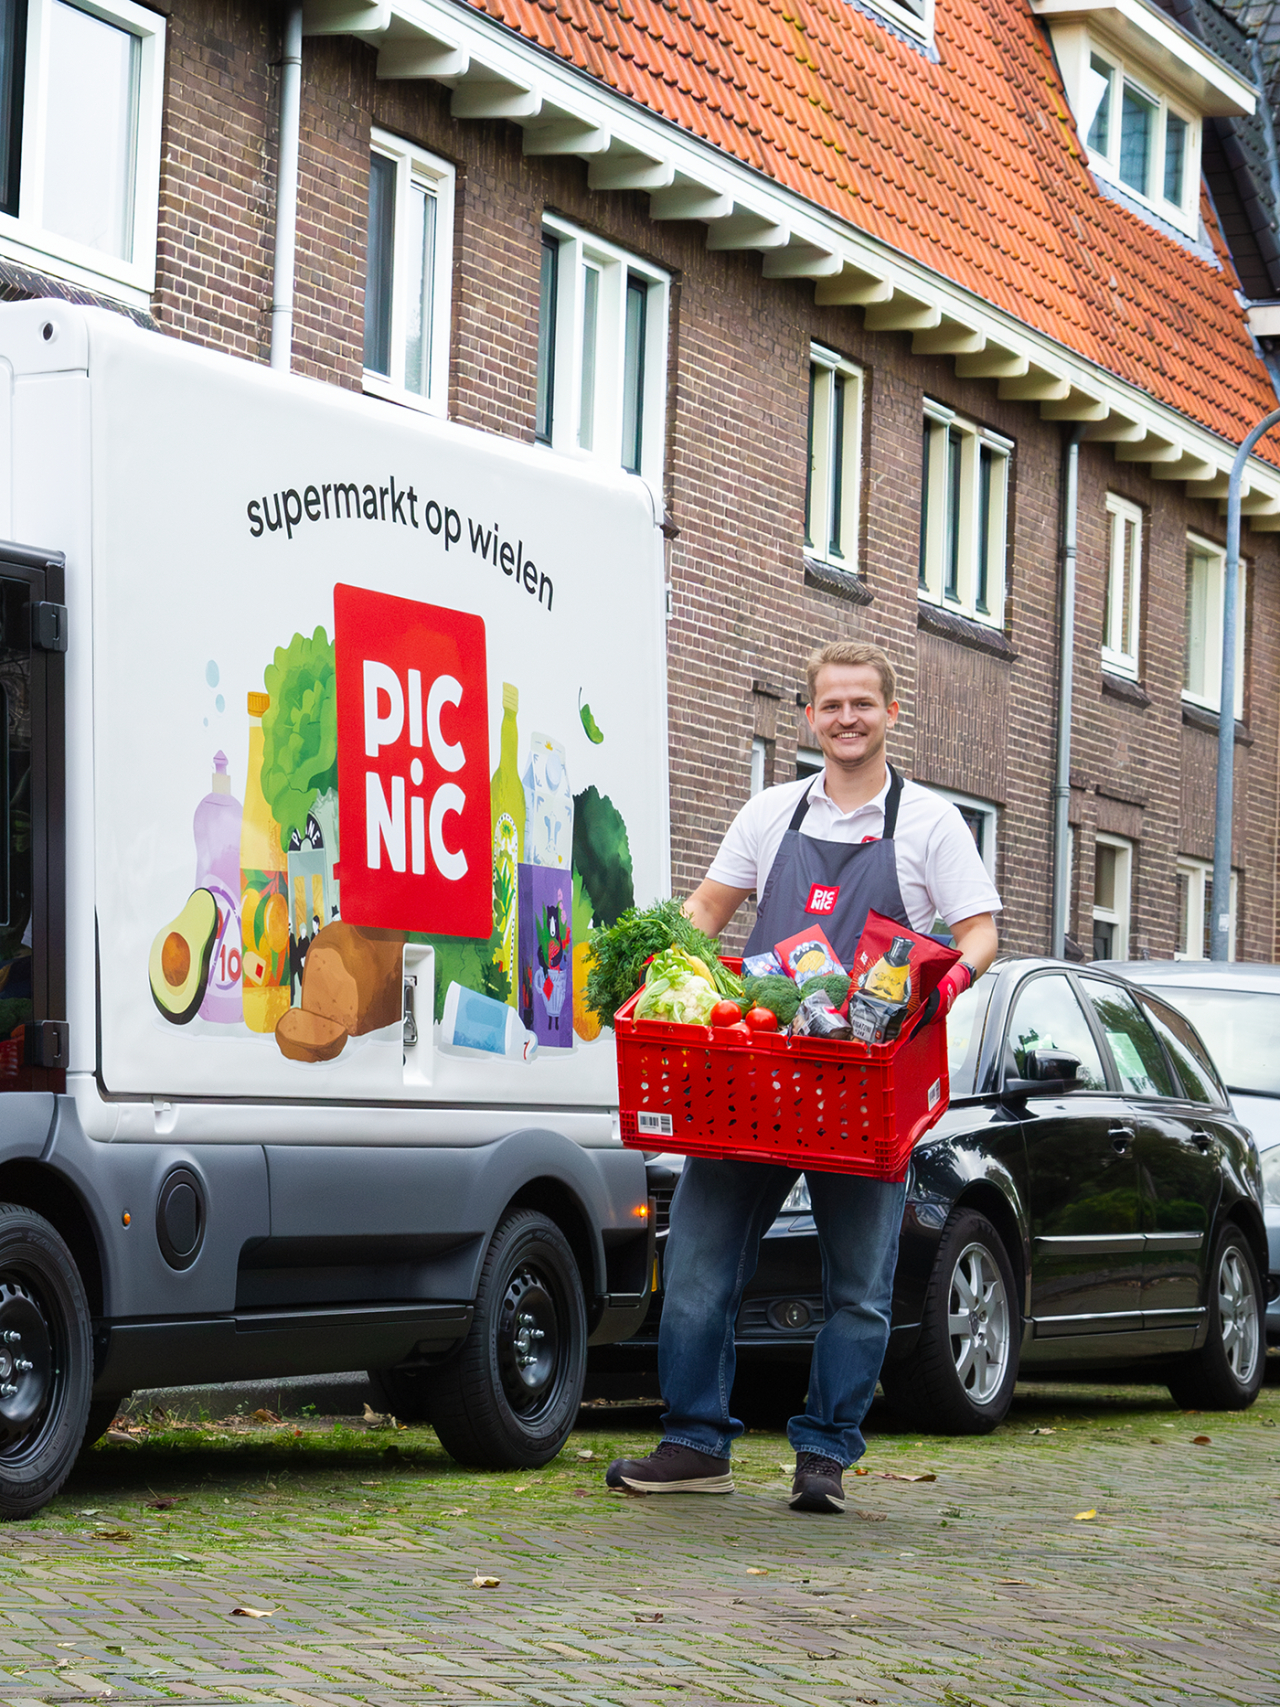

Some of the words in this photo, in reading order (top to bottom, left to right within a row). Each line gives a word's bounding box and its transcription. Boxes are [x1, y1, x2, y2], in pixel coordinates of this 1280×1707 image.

[247, 475, 419, 540] supermarkt
[425, 500, 462, 552] op
[468, 518, 554, 612] wielen
[363, 659, 467, 773] PIC
[813, 889, 835, 901] PIC
